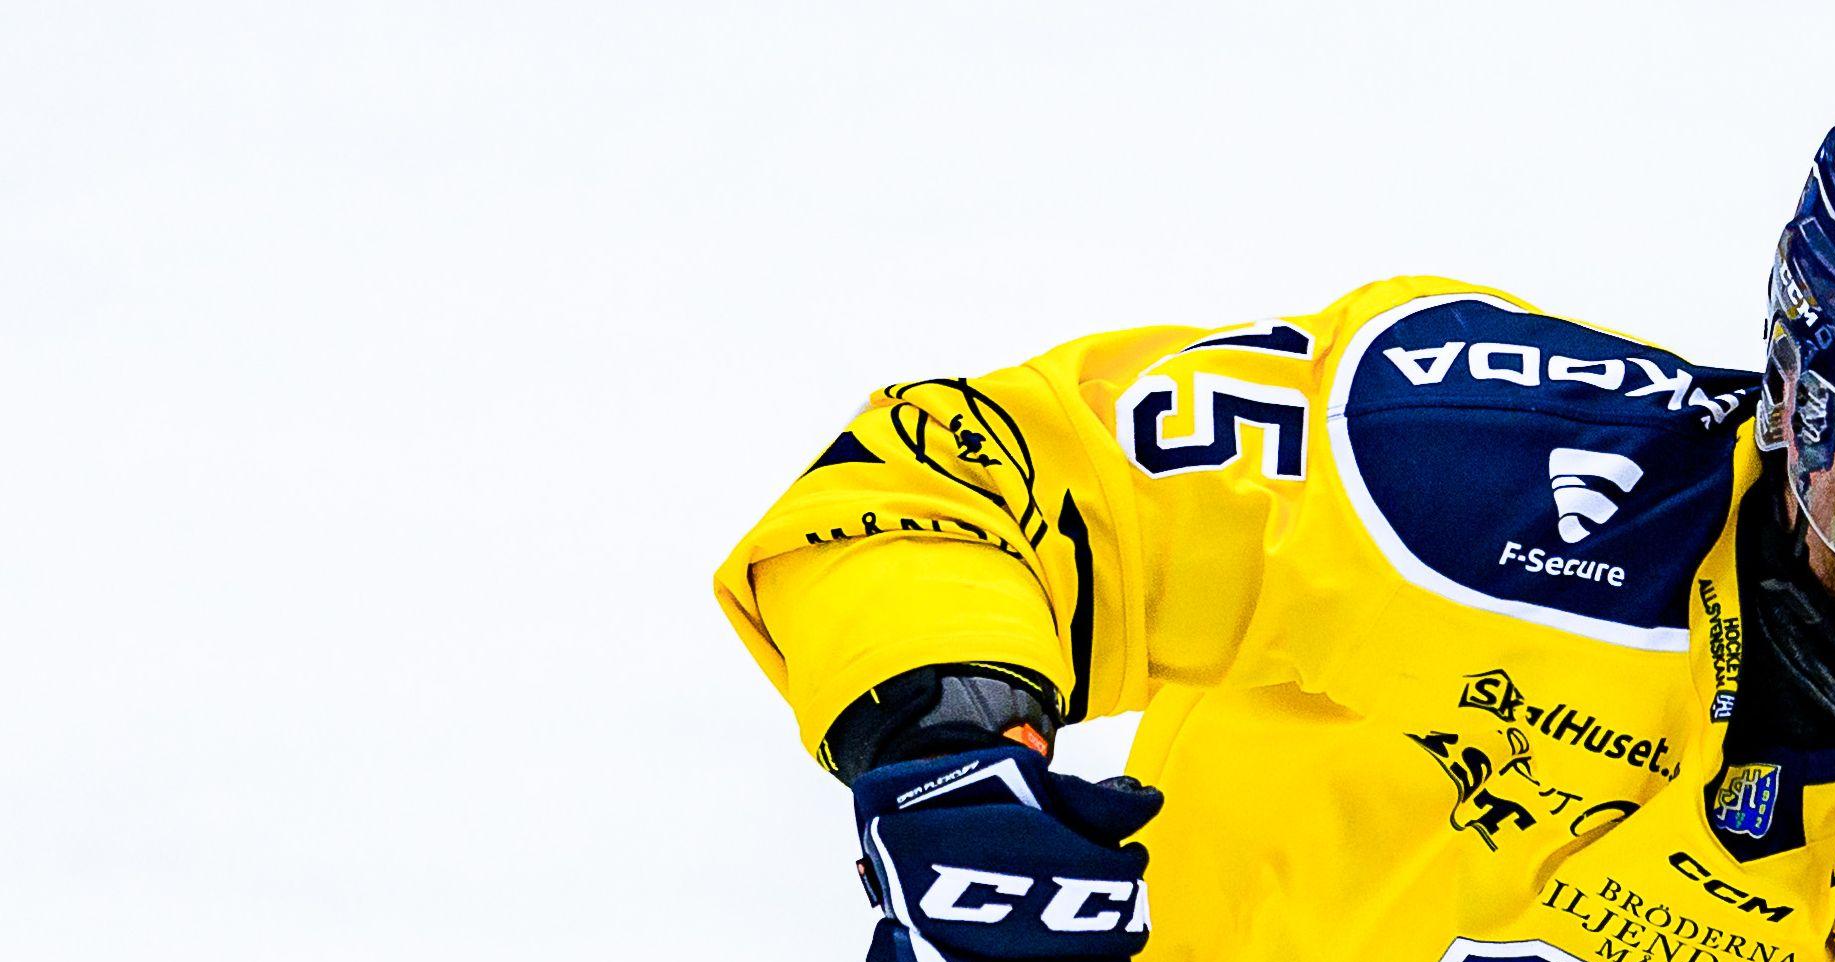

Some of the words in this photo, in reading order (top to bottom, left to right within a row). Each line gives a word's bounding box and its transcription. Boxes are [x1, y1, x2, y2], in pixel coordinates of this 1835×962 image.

[1779, 260, 1818, 327] CCM
[1499, 541, 1625, 588] F-Secure
[919, 864, 1153, 933] CC
[1668, 851, 1794, 923] CCM
